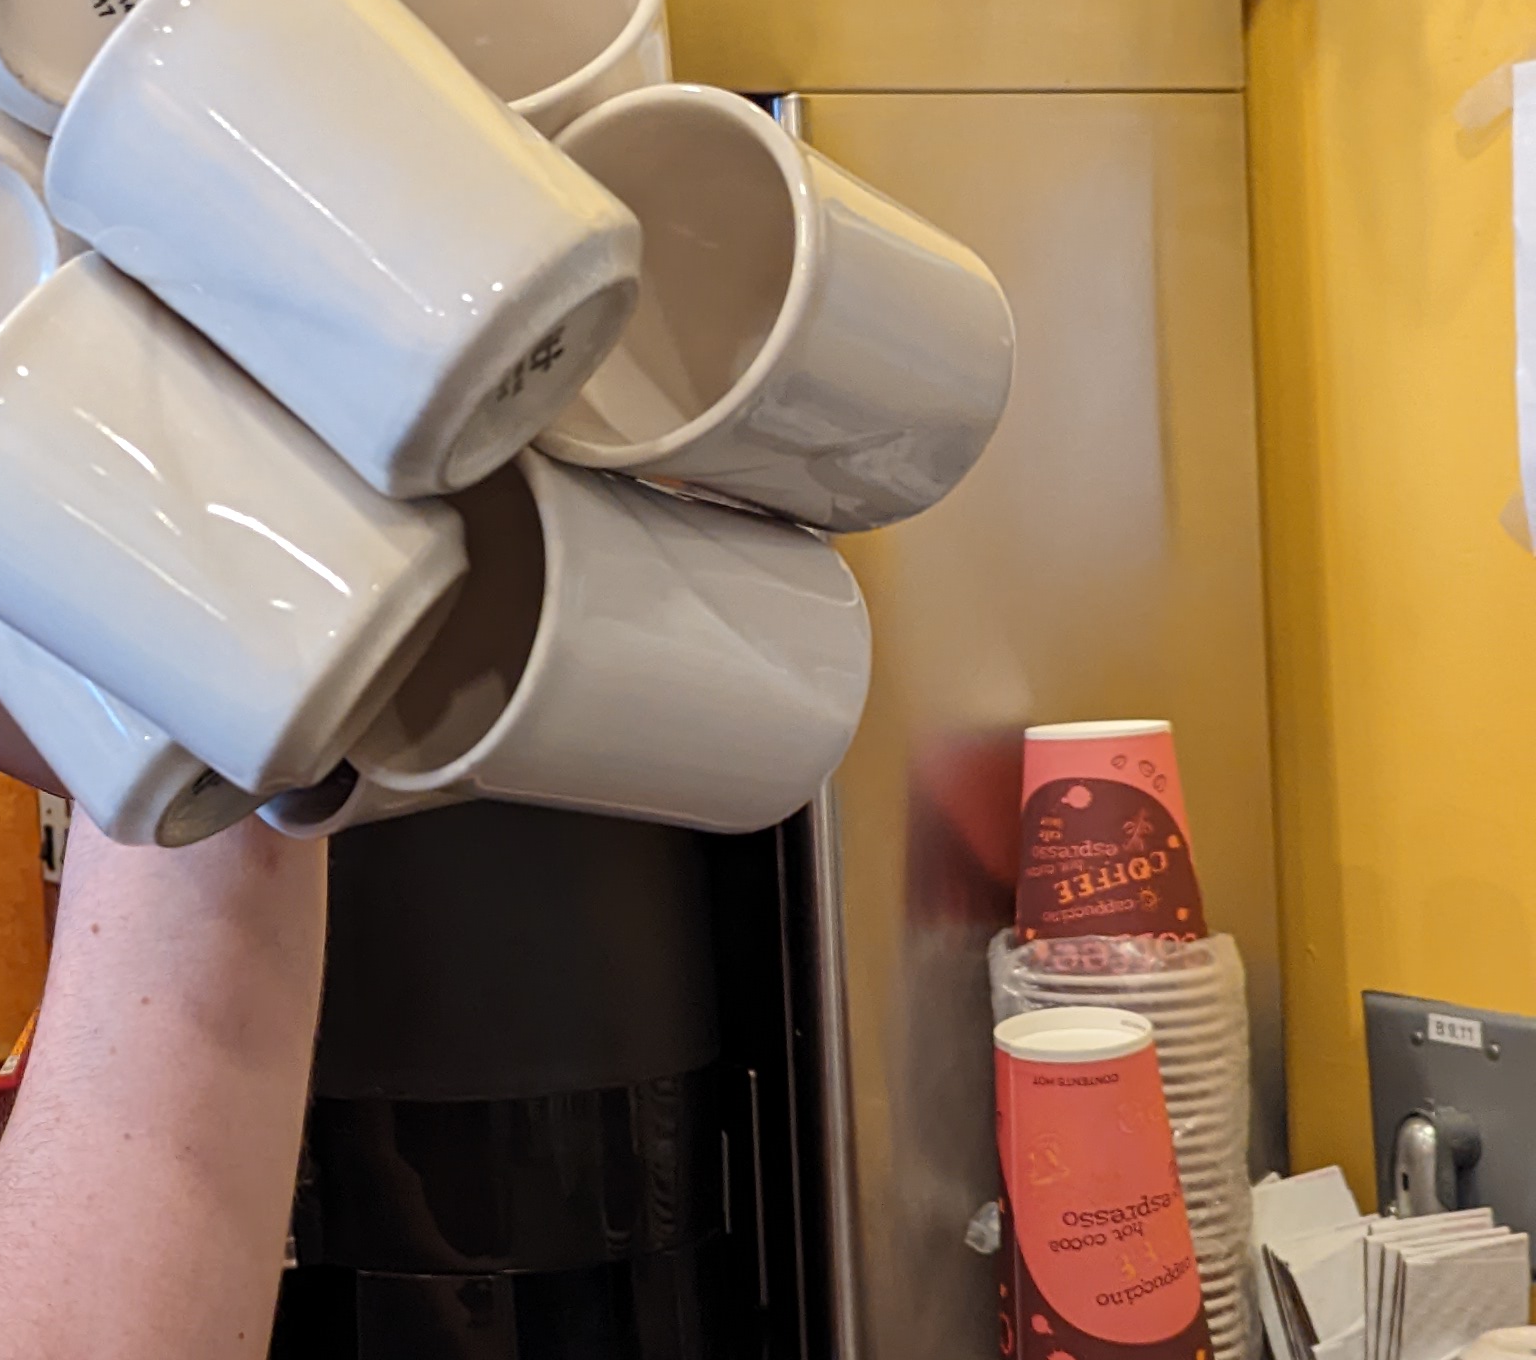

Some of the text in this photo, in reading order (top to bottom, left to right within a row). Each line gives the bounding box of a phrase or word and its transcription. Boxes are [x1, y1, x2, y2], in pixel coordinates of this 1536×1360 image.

[1053, 851, 1168, 905] COFFEE
[1031, 1072, 1120, 1087] CONTENTS HOT
[1061, 1193, 1174, 1227] espresso
[1048, 1220, 1145, 1253] hot cocoa
